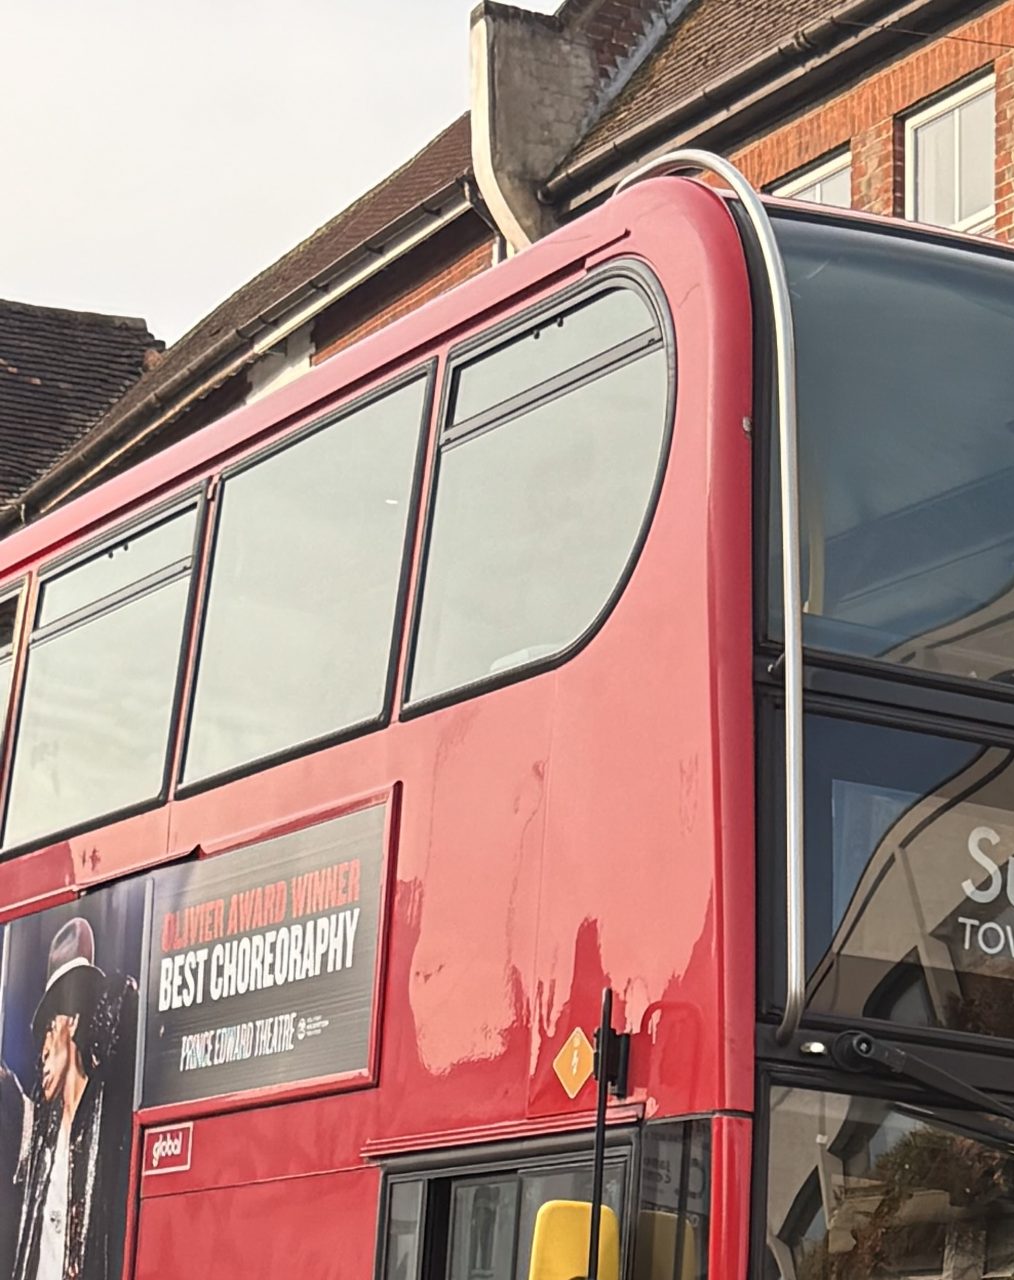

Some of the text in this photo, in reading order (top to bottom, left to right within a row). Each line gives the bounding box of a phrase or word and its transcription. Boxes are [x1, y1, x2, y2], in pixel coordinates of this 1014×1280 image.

[227, 880, 287, 936] AWARD
[292, 859, 360, 918] WINNER
[159, 948, 208, 1012] BEST
[254, 1012, 297, 1057] THEATRE
[153, 1131, 182, 1168] global
